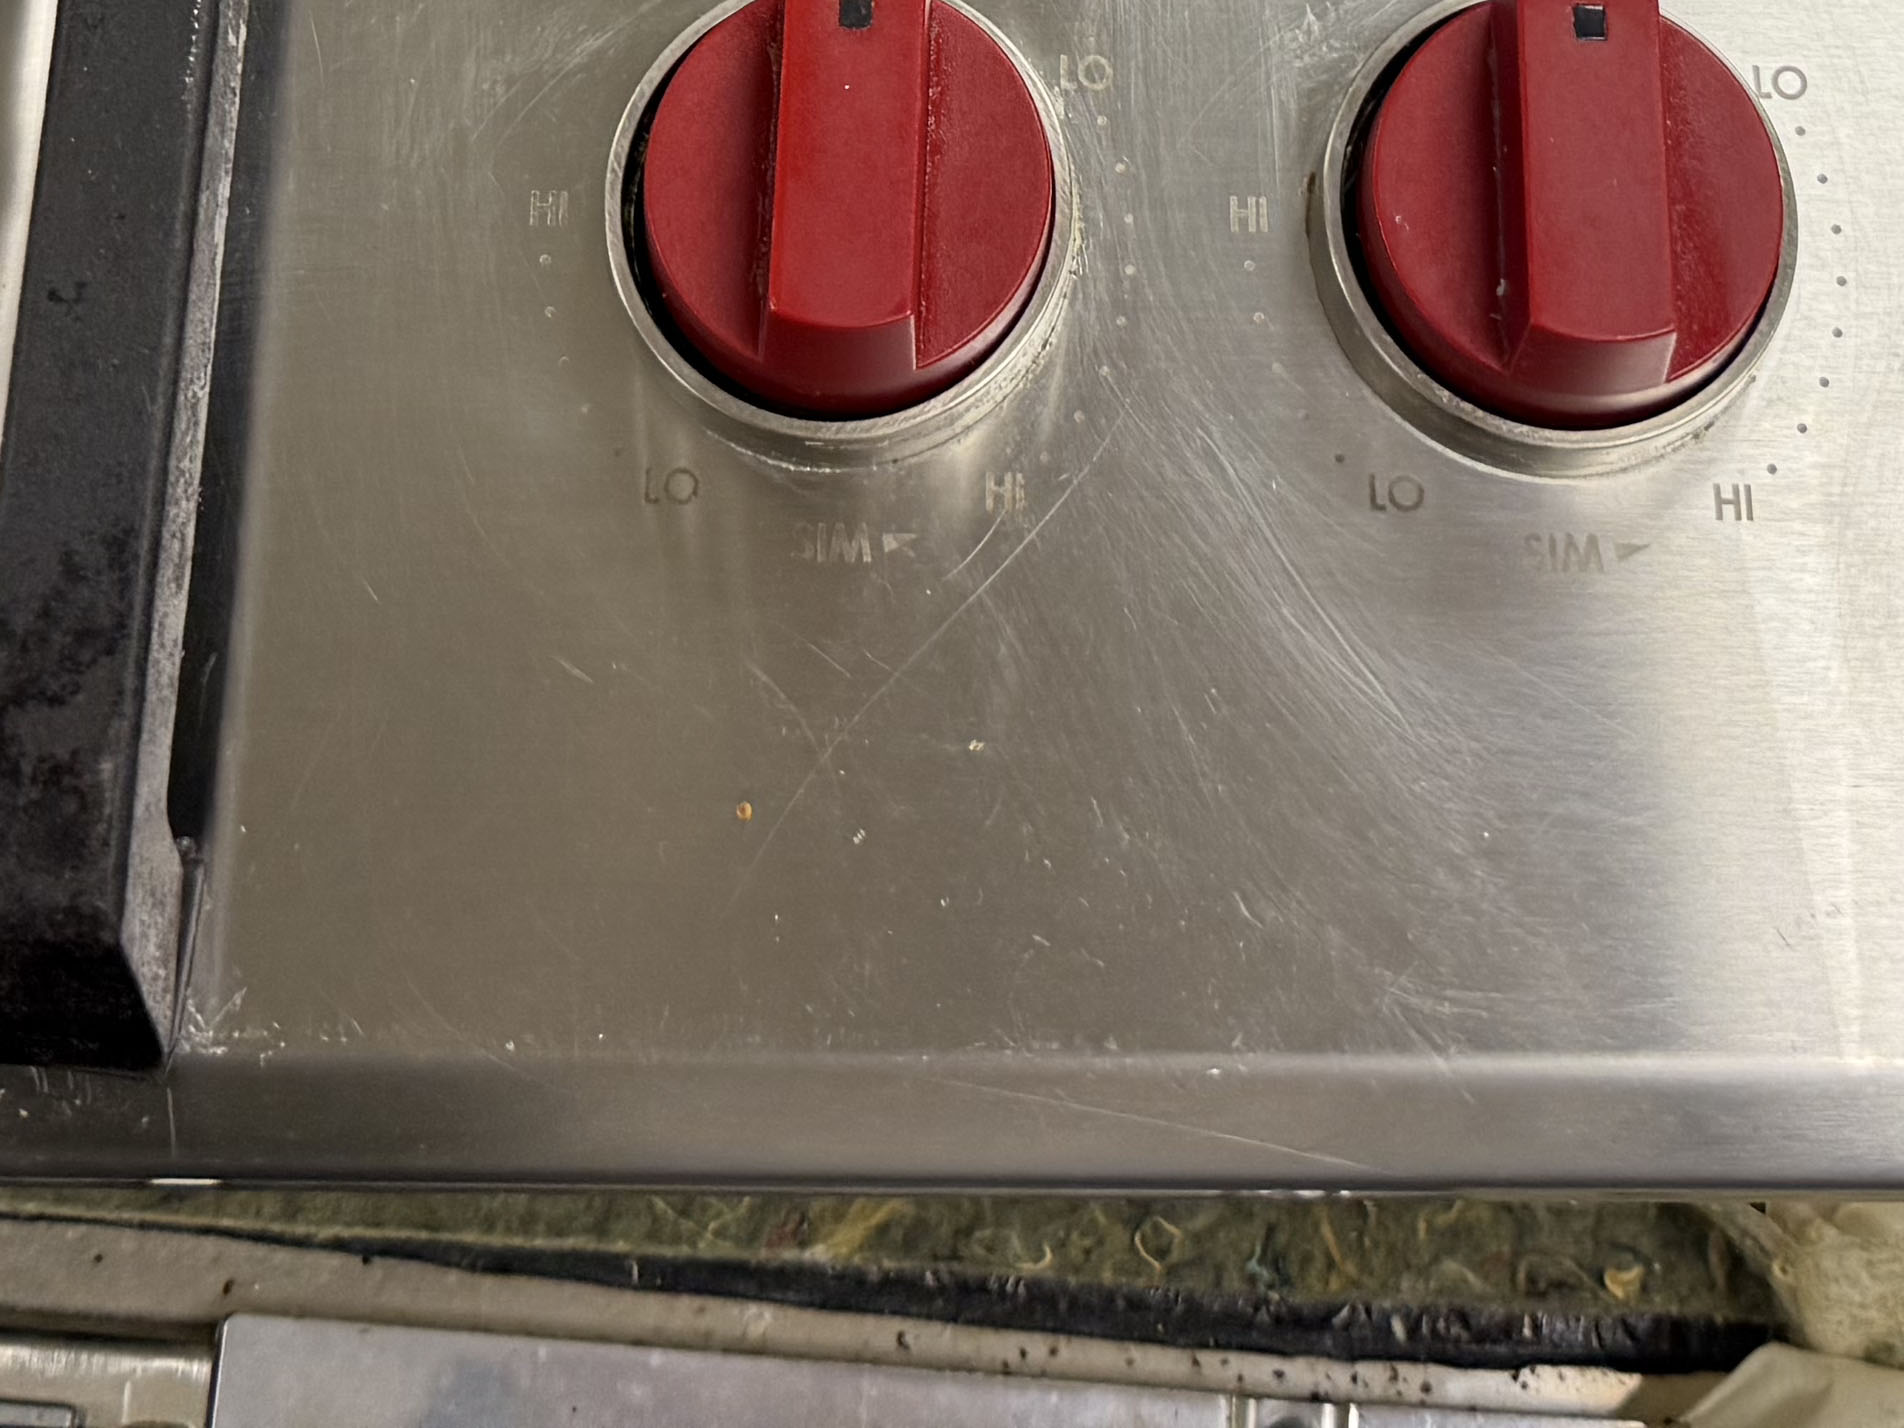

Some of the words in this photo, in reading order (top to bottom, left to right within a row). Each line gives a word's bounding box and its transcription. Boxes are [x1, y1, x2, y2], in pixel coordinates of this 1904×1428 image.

[1059, 54, 1112, 91] LO
[1751, 65, 1808, 101] LO
[529, 190, 568, 227] HI
[1229, 196, 1268, 233] HI
[644, 467, 699, 505] LO
[985, 472, 1026, 512] HI
[1368, 474, 1425, 512] LO
[1714, 484, 1754, 521] HI
[796, 523, 873, 563] SIM
[1526, 534, 1605, 574] SIM
